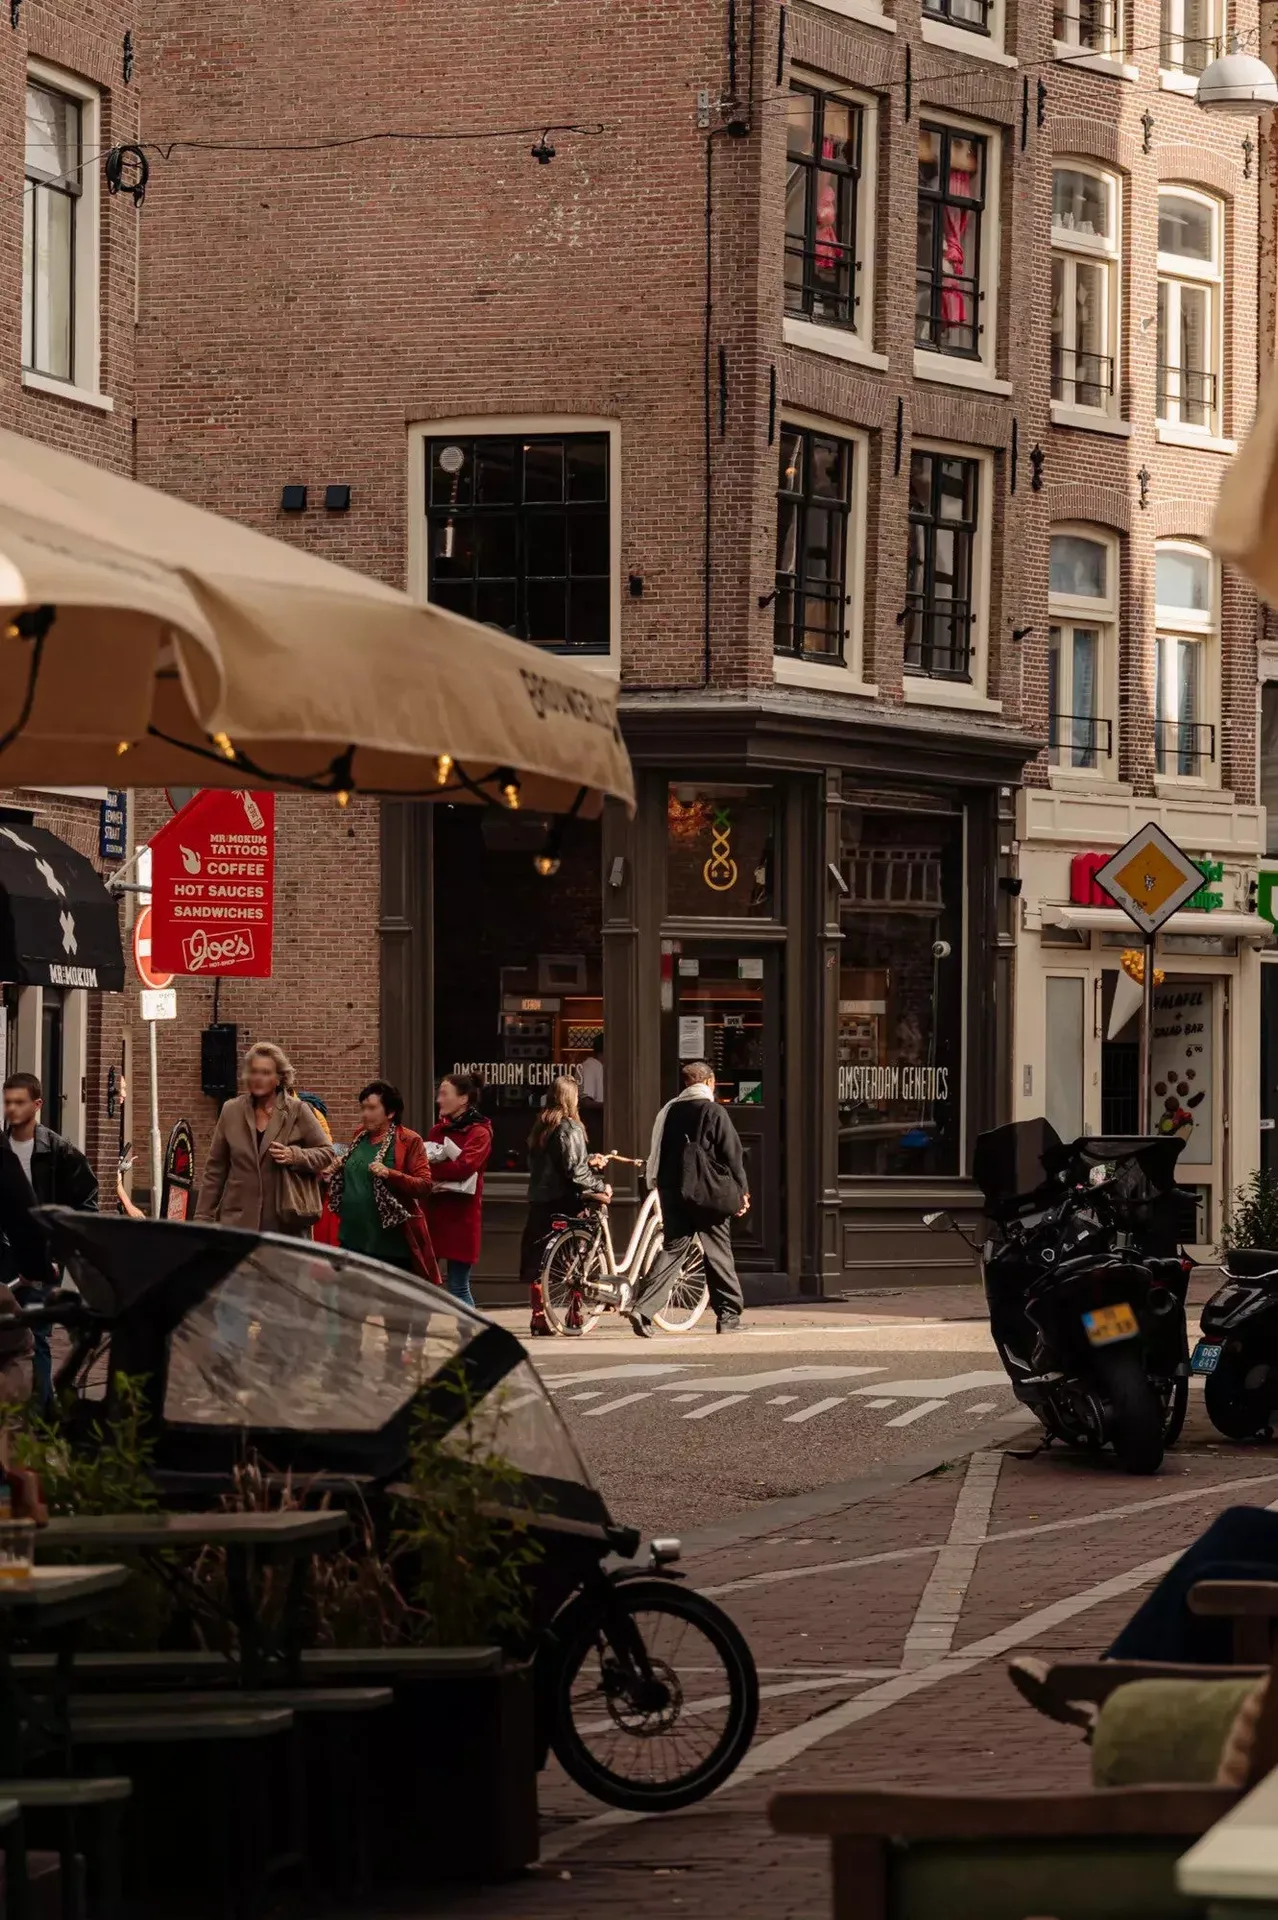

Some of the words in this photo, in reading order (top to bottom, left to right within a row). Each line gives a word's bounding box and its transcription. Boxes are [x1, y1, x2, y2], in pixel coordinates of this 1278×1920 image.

[229, 834, 267, 844] MOKUM
[210, 844, 268, 856] TATTOOS
[206, 862, 265, 876] COFFEE
[174, 884, 204, 896] HOT
[208, 885, 264, 898] SAUCES
[174, 905, 264, 919] SANDWICHES
[189, 929, 250, 972] Joe's
[1184, 1023, 1204, 1035] BAR
[838, 1066, 899, 1100] AMSTERDAM
[902, 1066, 949, 1100] GENETICS
